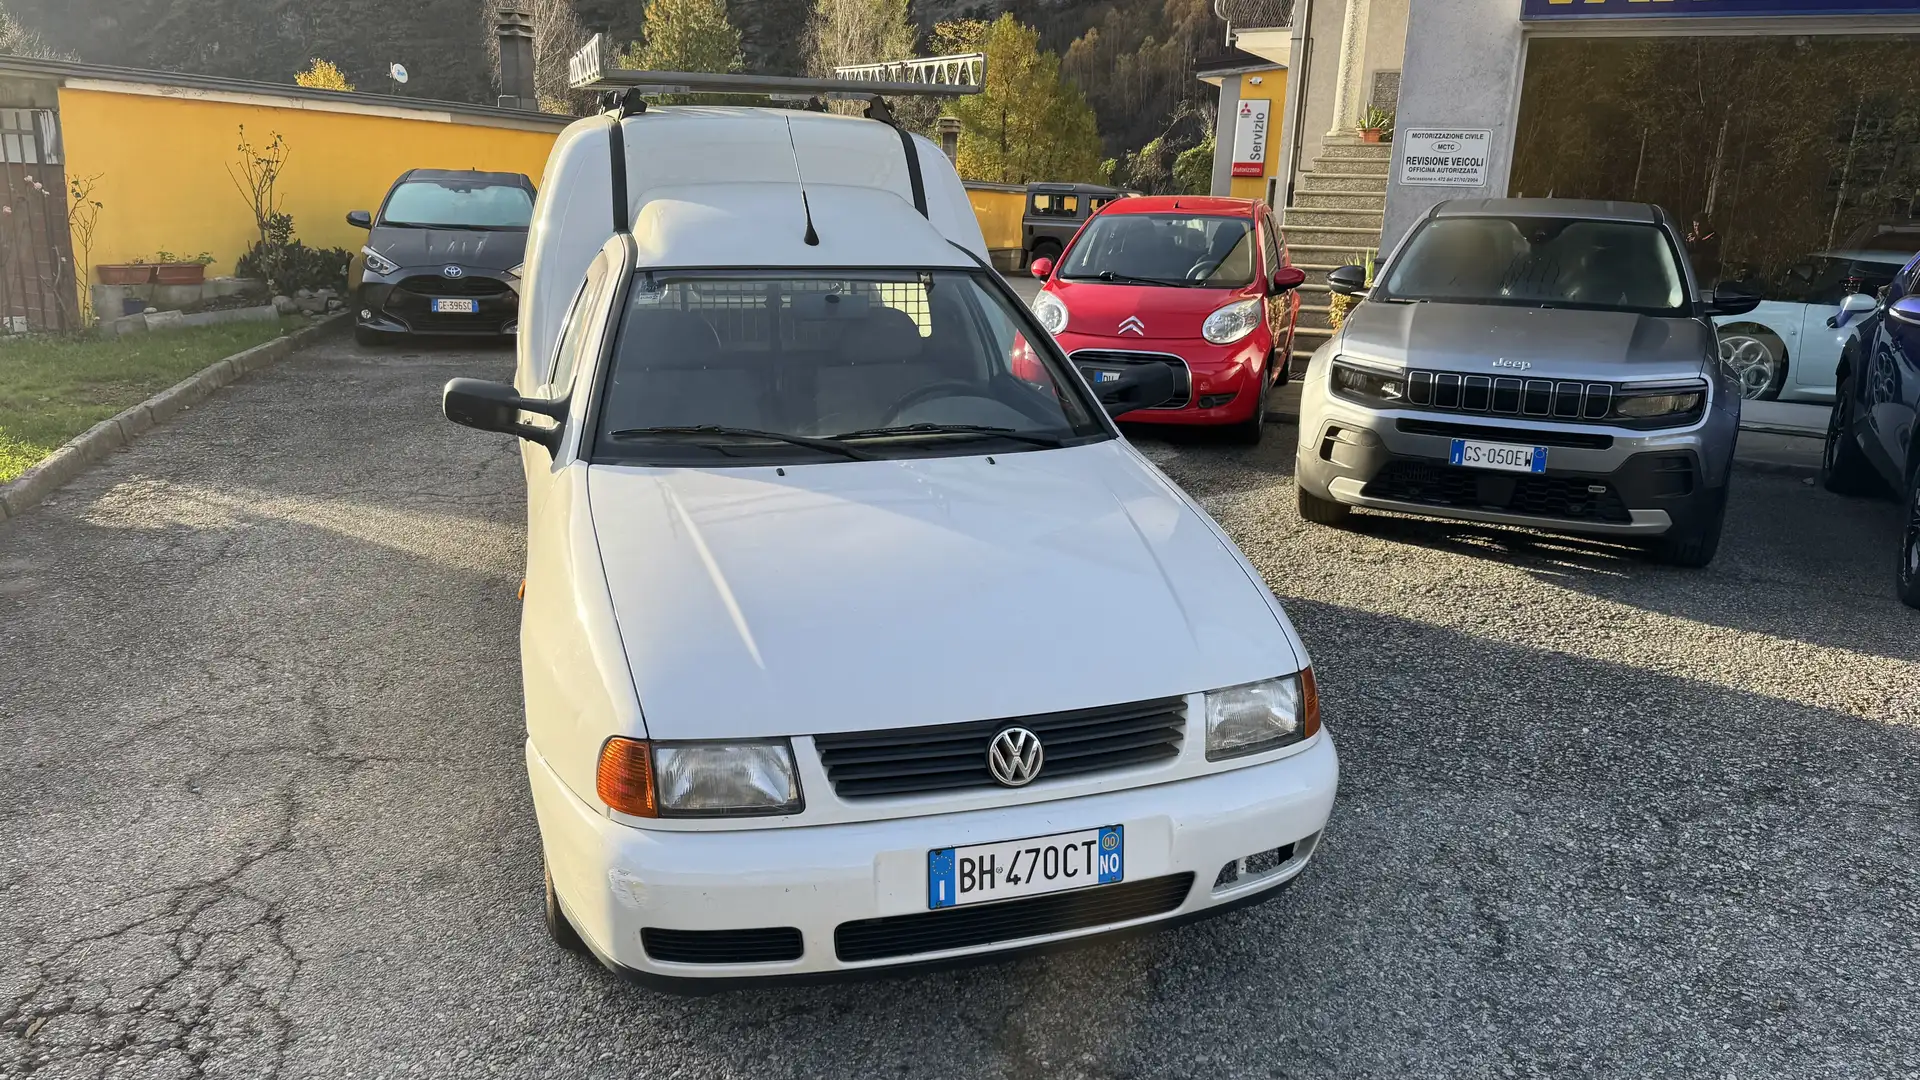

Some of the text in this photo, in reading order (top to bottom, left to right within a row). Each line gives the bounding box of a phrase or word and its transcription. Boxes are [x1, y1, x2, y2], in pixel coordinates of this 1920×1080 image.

[1250, 113, 1265, 160] Servizio
[1411, 132, 1463, 140] MOTORIZZAZIONE
[1406, 156, 1484, 167] REVISIONE VEICOLI
[1492, 357, 1532, 371] Jeep
[1099, 853, 1120, 875] NO
